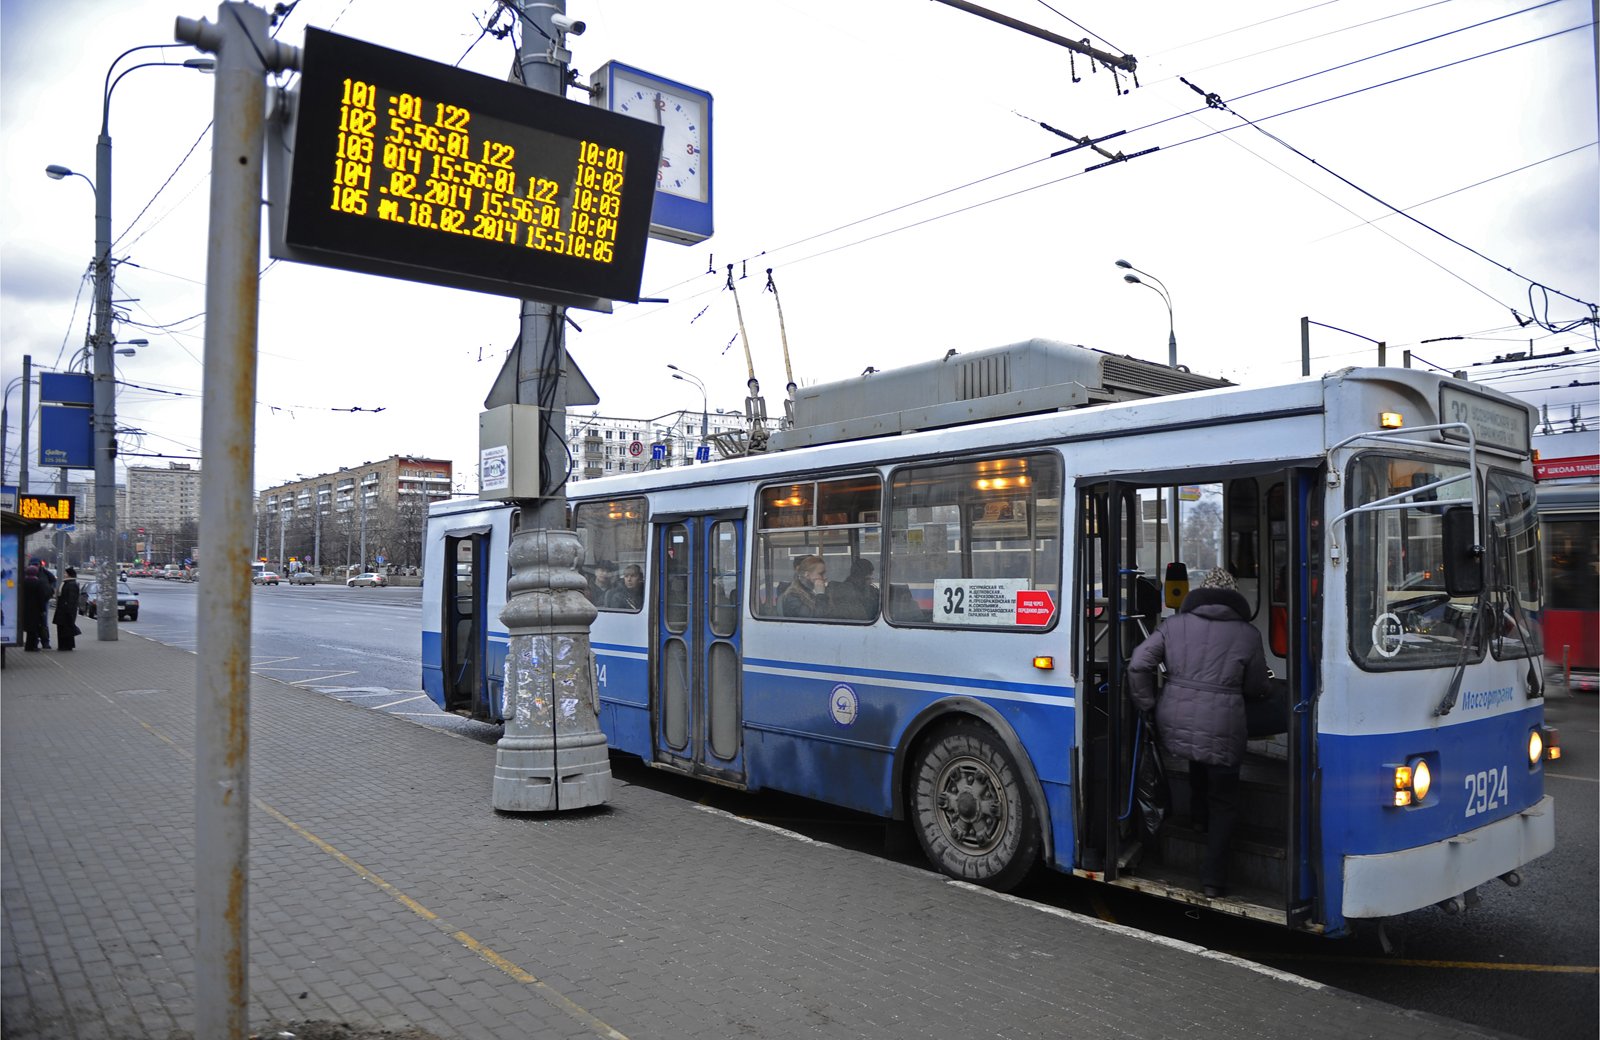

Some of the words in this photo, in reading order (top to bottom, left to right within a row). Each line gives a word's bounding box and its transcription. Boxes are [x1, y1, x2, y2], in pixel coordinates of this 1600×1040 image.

[339, 106, 376, 137] 102
[481, 141, 514, 169] 122
[576, 164, 623, 195] 10:02
[342, 79, 376, 111] 101
[388, 93, 422, 122] :01
[435, 103, 470, 133] 122
[578, 141, 624, 172] 10:01
[687, 144, 694, 155] 3
[331, 185, 368, 215] 105
[334, 159, 371, 190] 104
[380, 172, 472, 210] .02.2014
[481, 191, 560, 229] 15:56:01
[569, 211, 617, 240] 10:04
[337, 132, 374, 163] 103
[383, 143, 421, 174] 014
[431, 155, 515, 195] 15:56:01
[527, 177, 558, 204] 122
[572, 187, 620, 218] 10:03
[1548, 466, 1575, 474] ШКОЛА
[943, 587, 965, 614] 32
[1464, 766, 1509, 817] 2924
